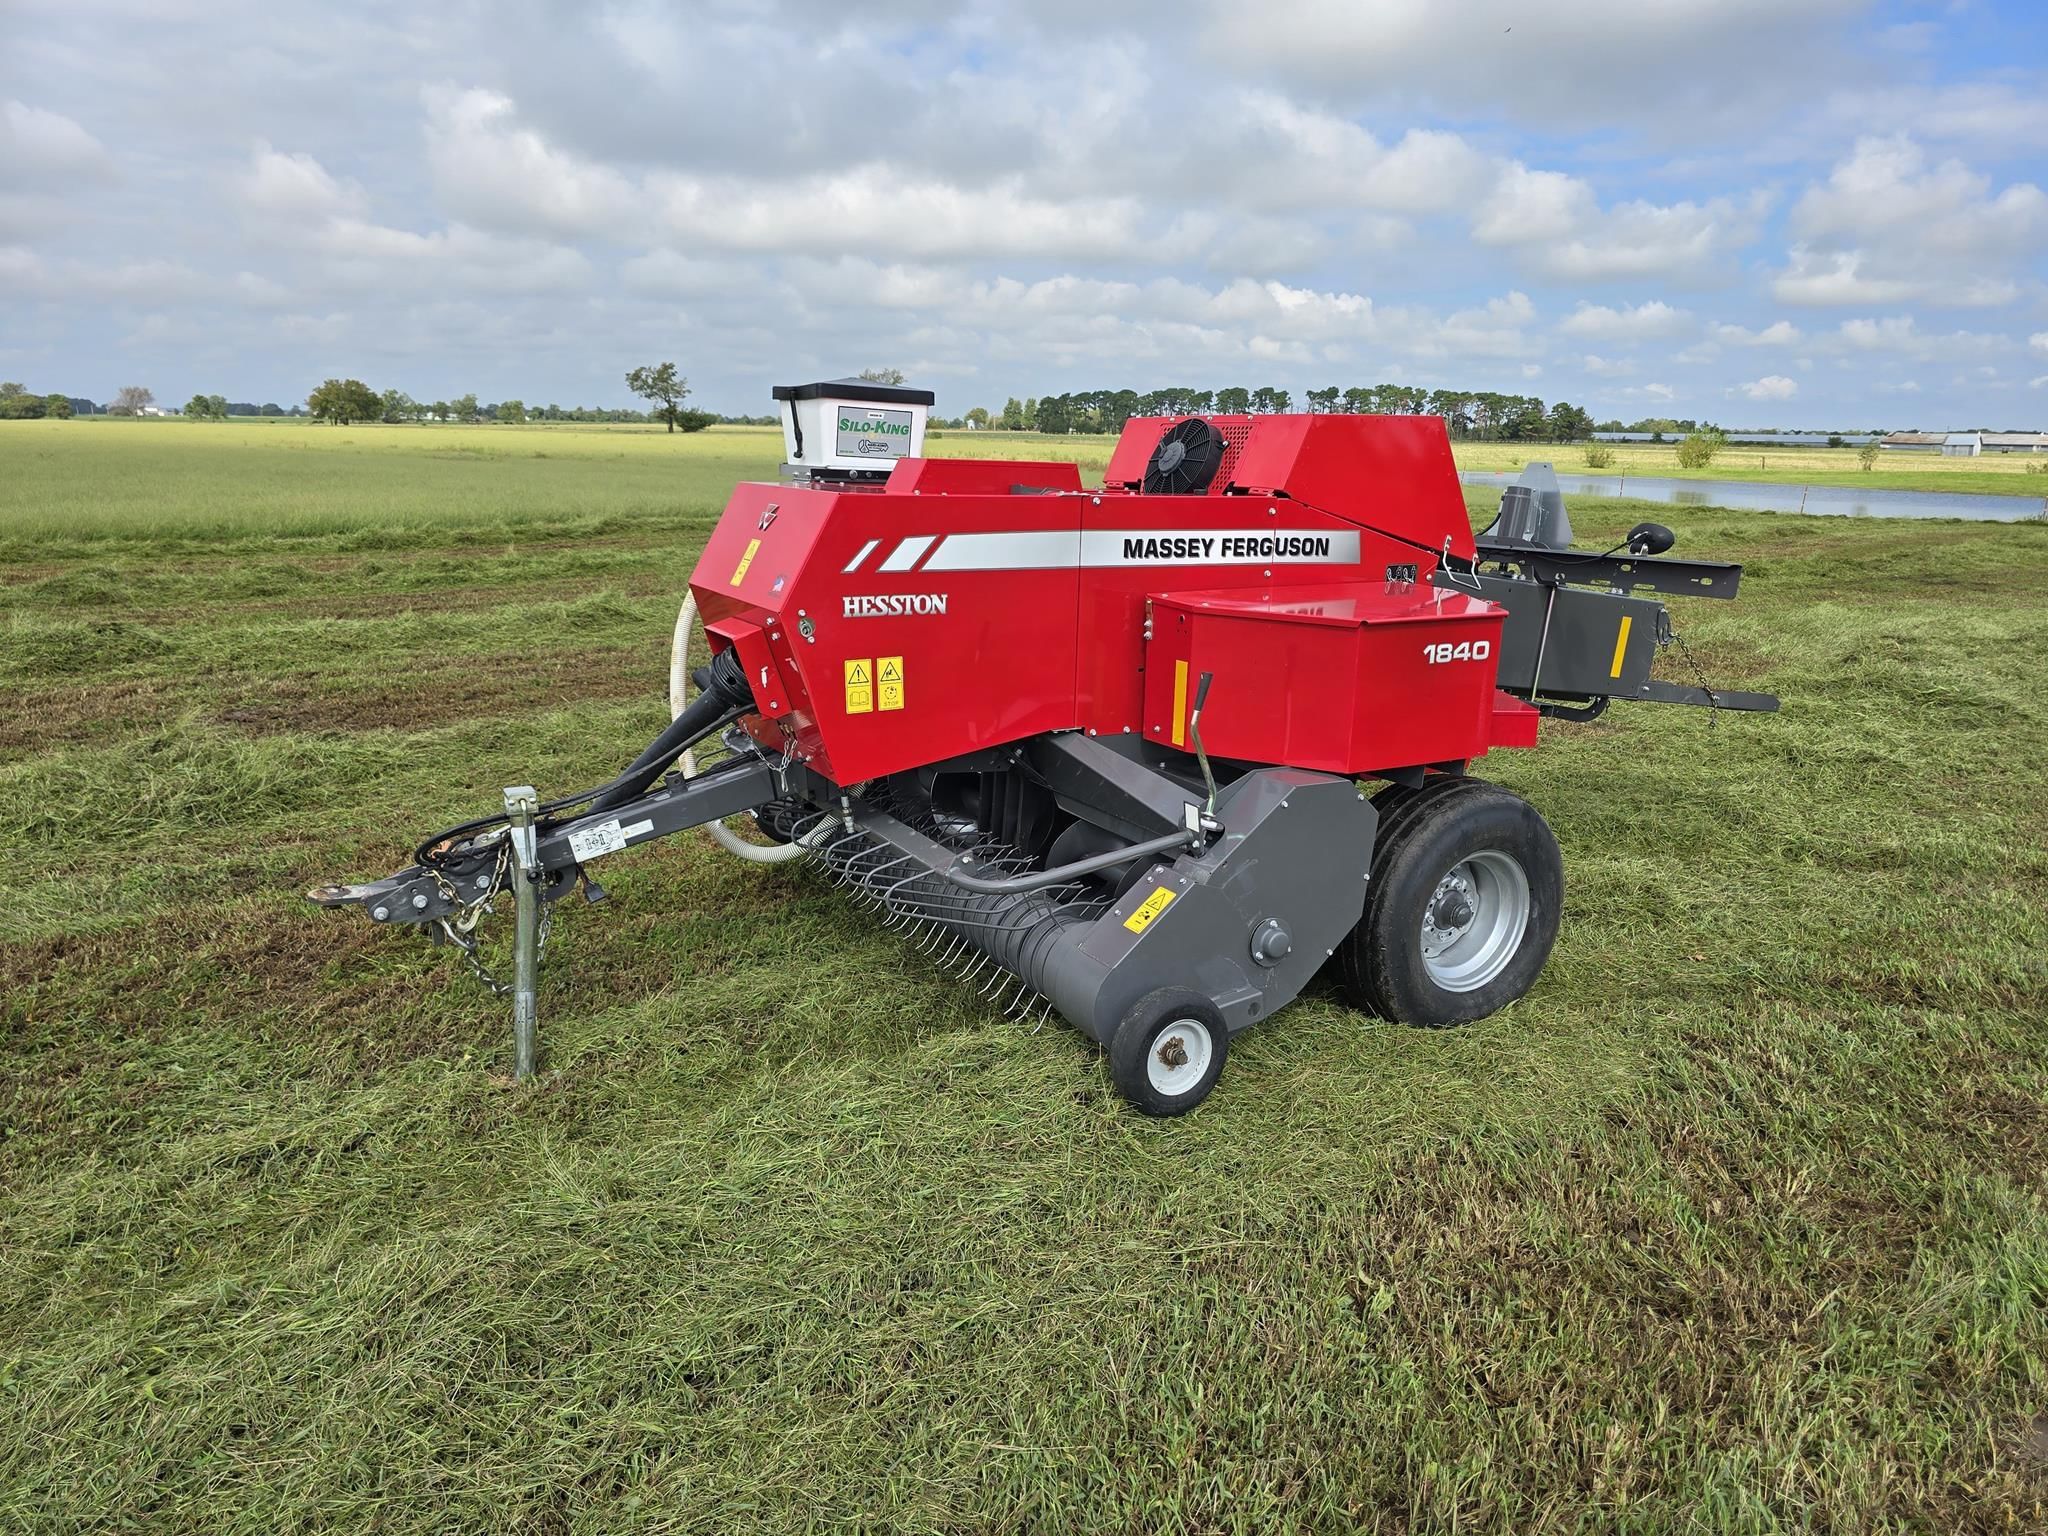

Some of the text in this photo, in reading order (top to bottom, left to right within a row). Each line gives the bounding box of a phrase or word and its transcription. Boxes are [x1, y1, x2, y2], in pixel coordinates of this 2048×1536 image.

[1123, 537, 1330, 559] MASSEY FERGUSON
[842, 594, 948, 618] HESSTON
[1423, 640, 1490, 664] 1840
